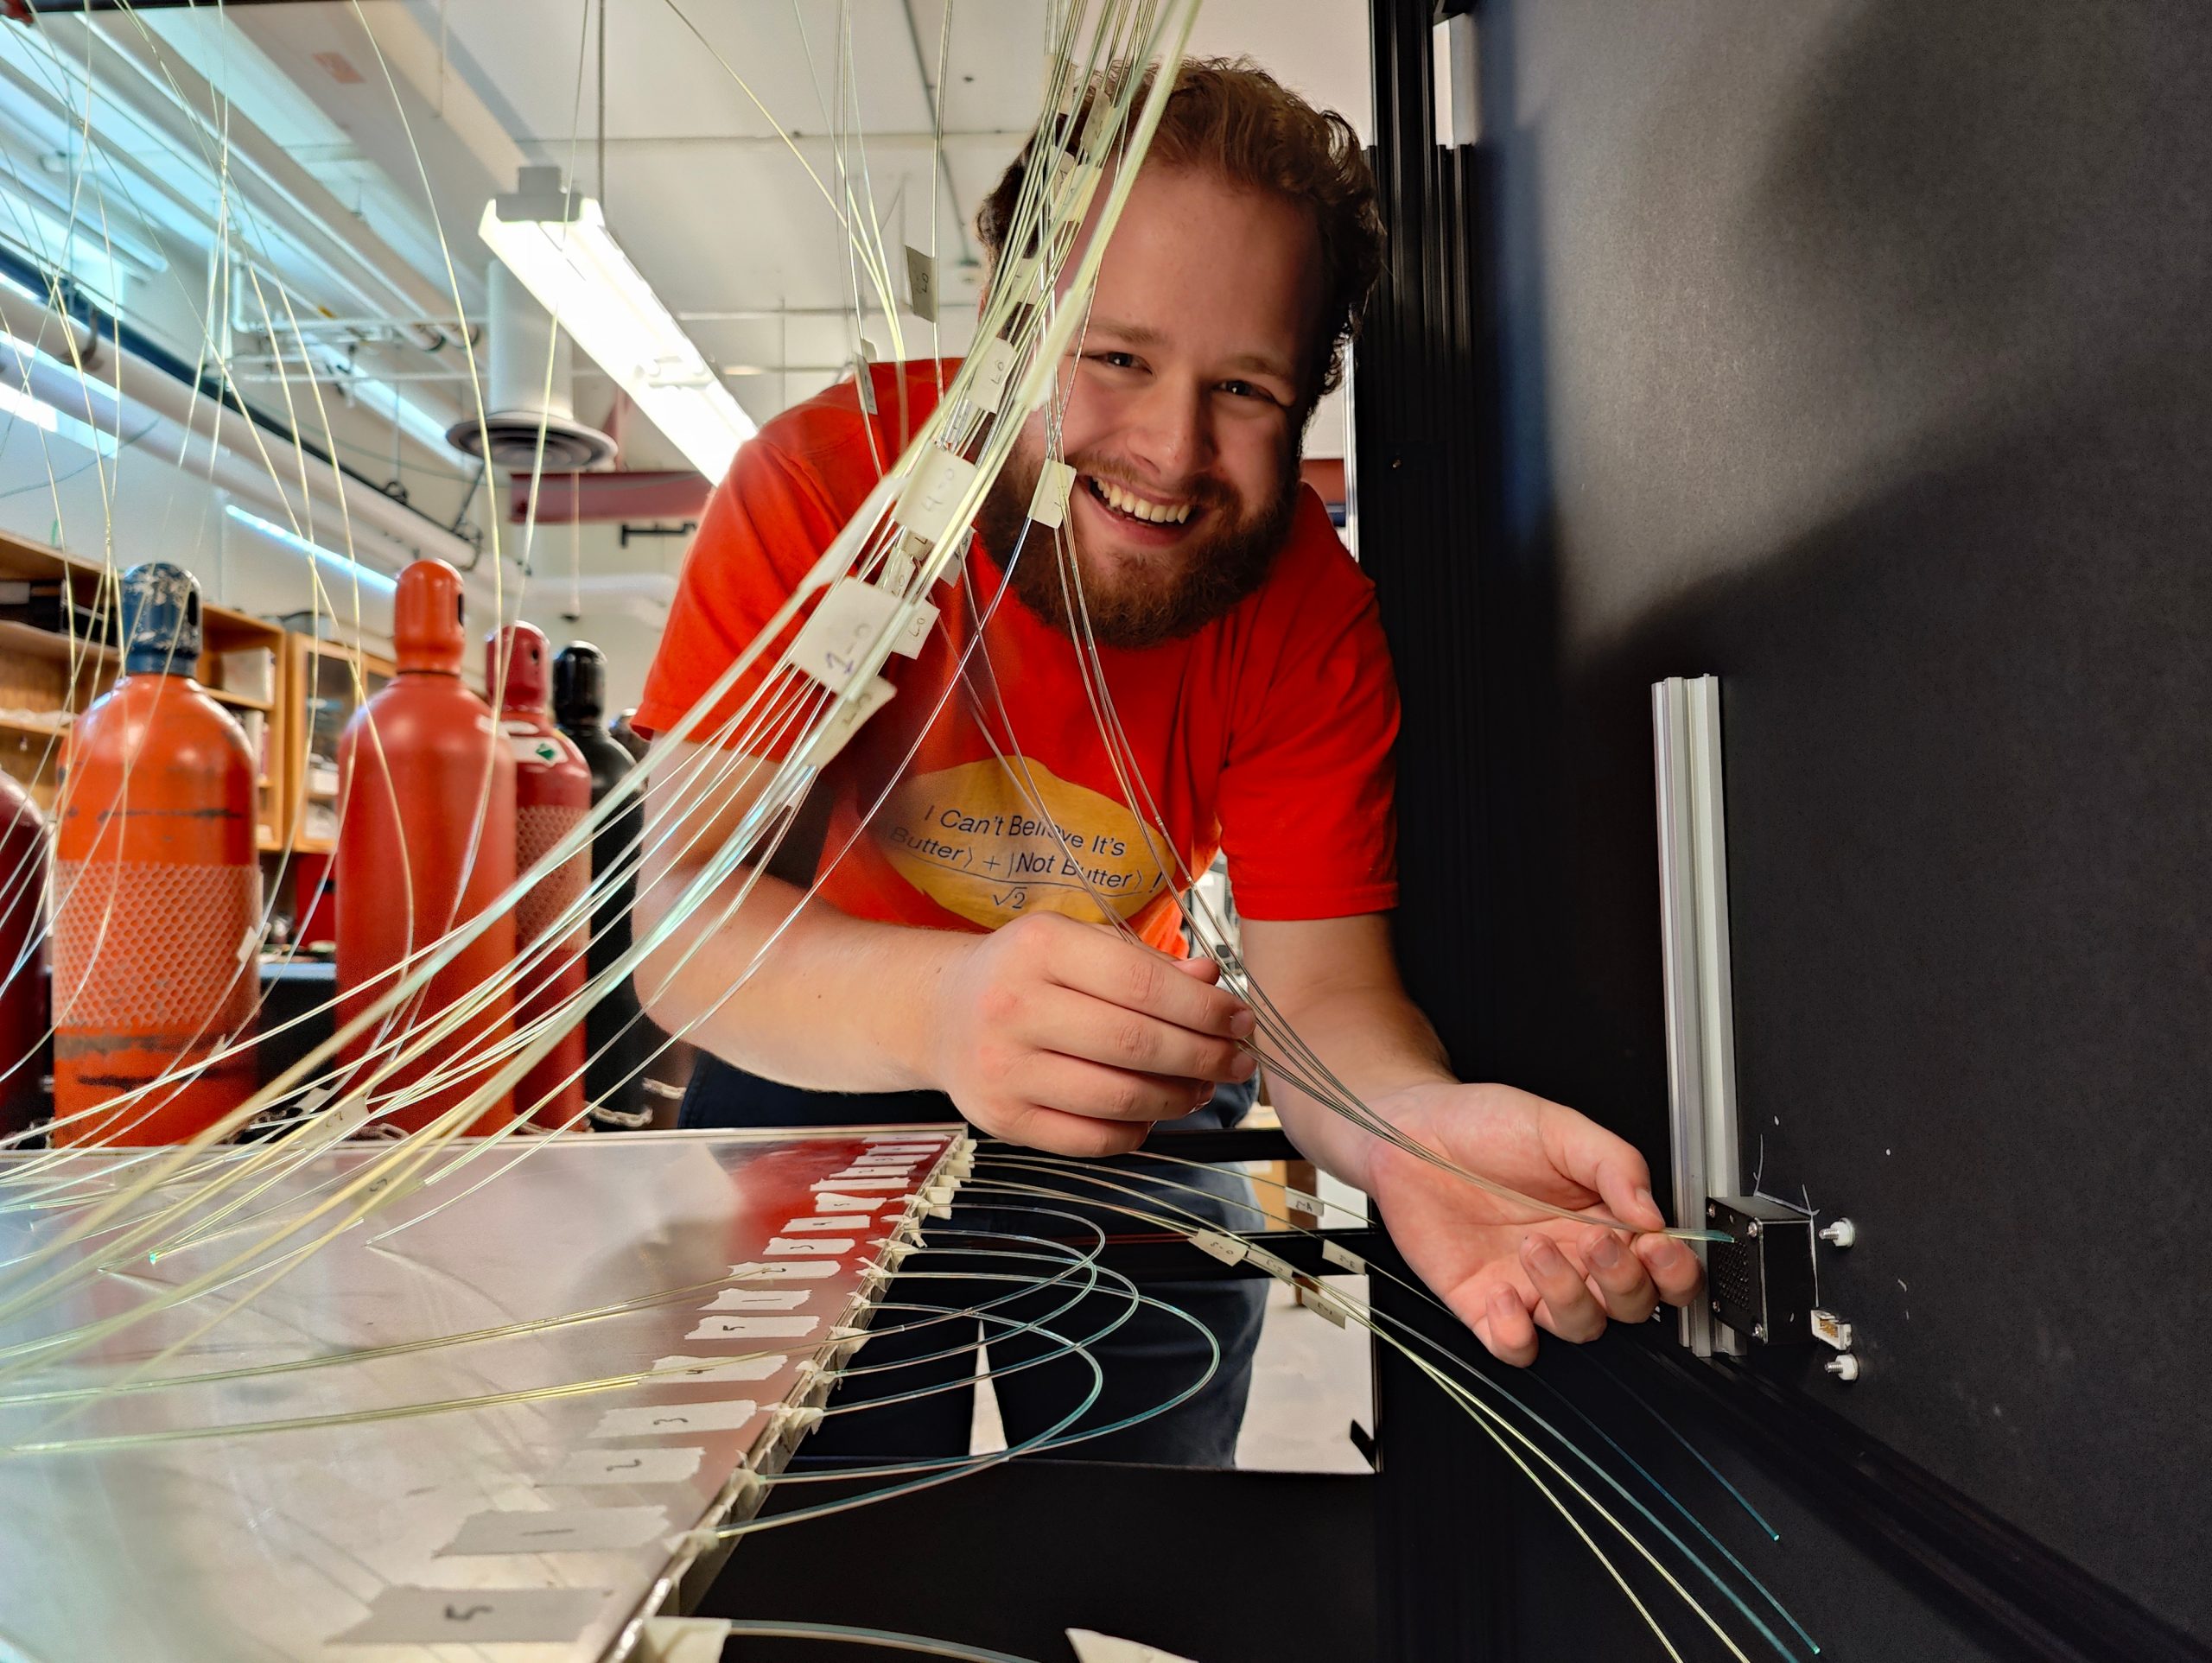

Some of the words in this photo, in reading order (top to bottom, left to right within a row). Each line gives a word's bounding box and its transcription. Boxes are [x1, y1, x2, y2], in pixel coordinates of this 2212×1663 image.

[925, 804, 935, 822] I
[939, 809, 1005, 836] Can't
[1091, 835, 1126, 856] It's
